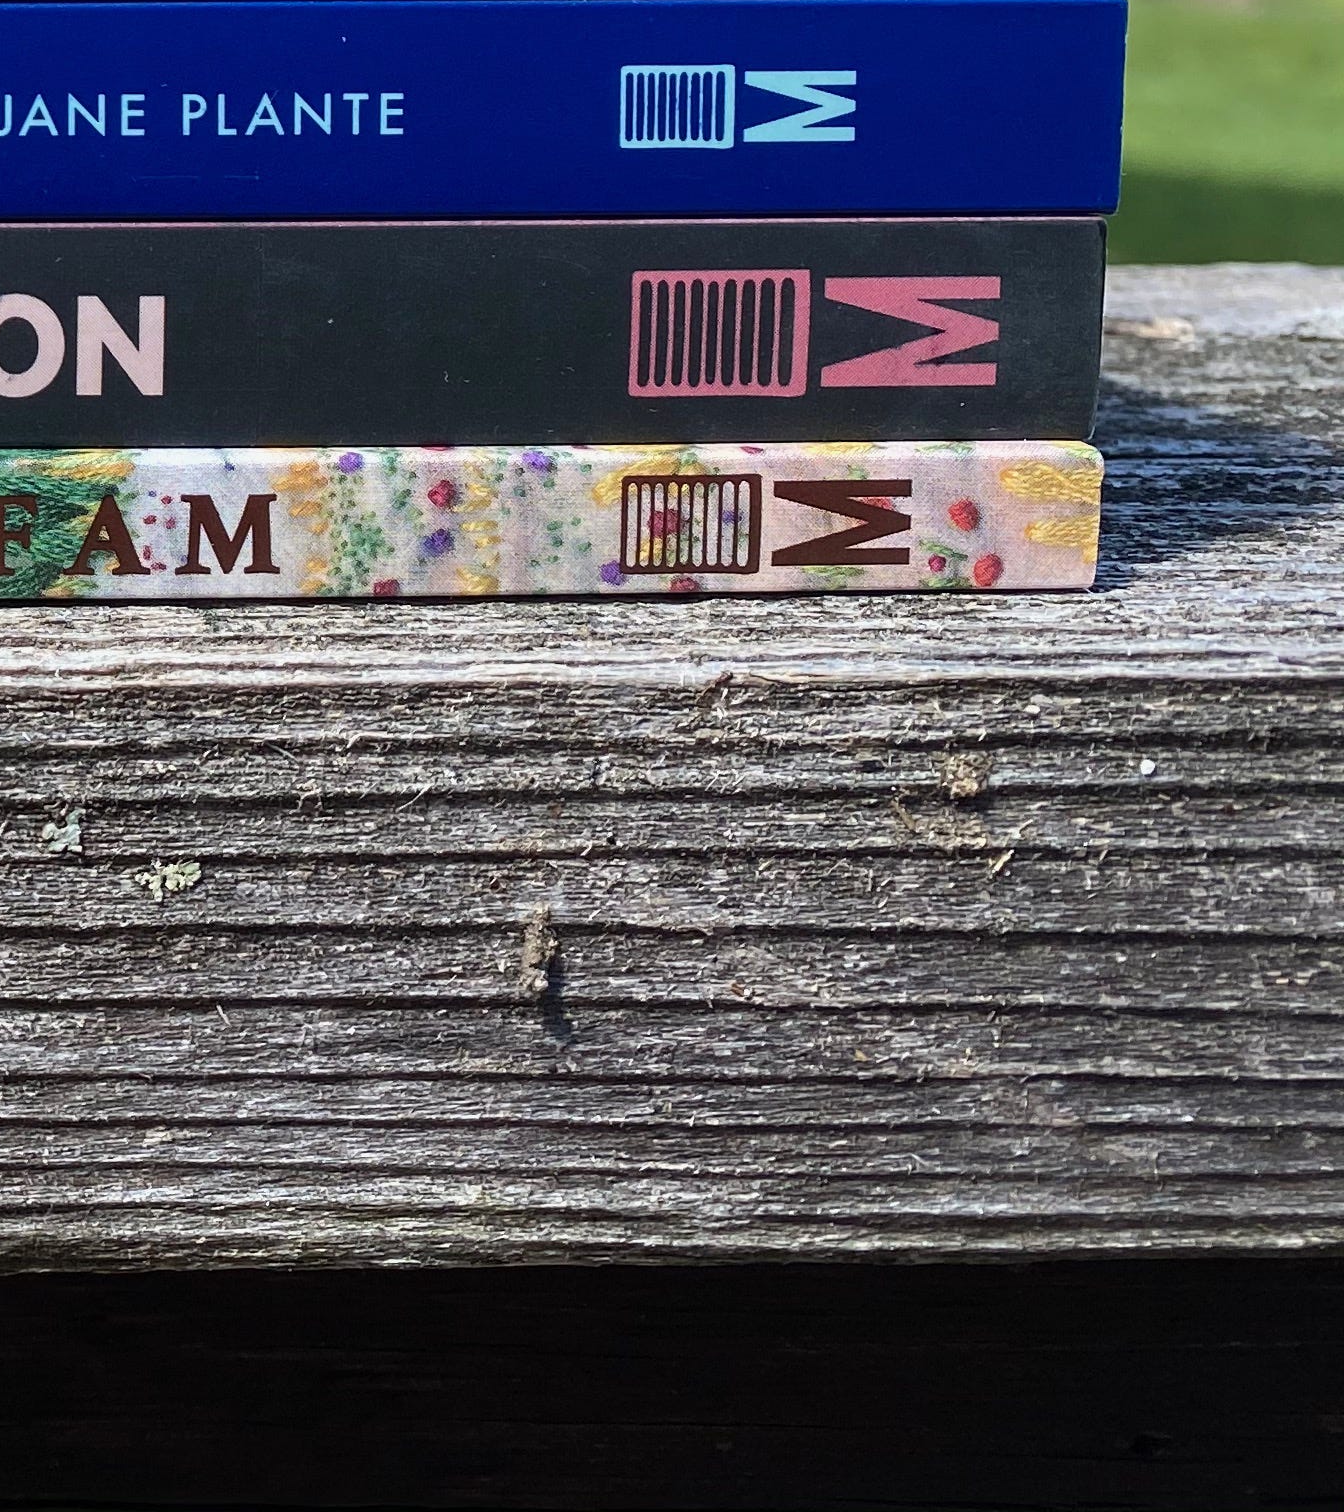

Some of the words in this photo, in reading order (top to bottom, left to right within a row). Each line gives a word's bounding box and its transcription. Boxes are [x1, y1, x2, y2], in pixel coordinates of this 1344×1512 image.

[182, 92, 405, 136] PLANTE
[743, 70, 857, 143] M
[820, 276, 1001, 388] M
[771, 479, 912, 566] M
